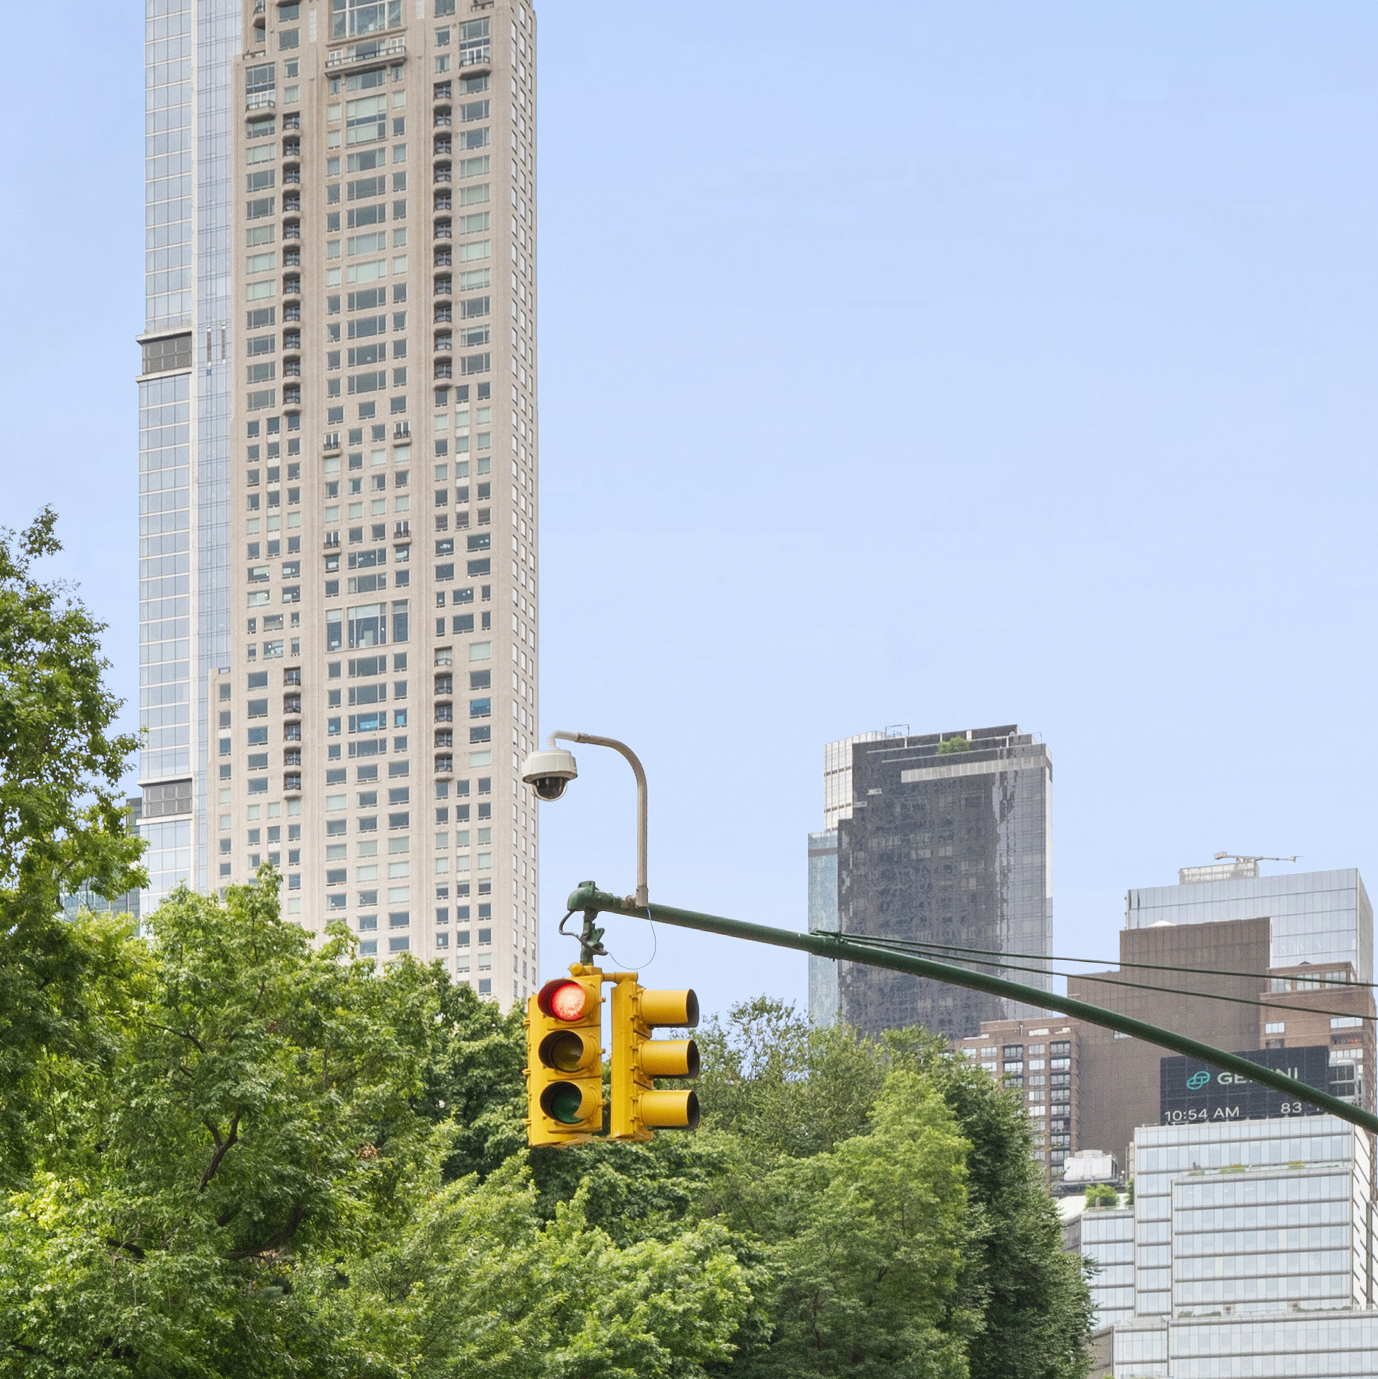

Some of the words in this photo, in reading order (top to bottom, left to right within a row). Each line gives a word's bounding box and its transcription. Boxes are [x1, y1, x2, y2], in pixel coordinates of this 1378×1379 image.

[1217, 1067, 1299, 1085] GENI
[1164, 1108, 1208, 1122] 10:54
[1213, 1106, 1240, 1119] AM
[1280, 1102, 1302, 1113] 83
